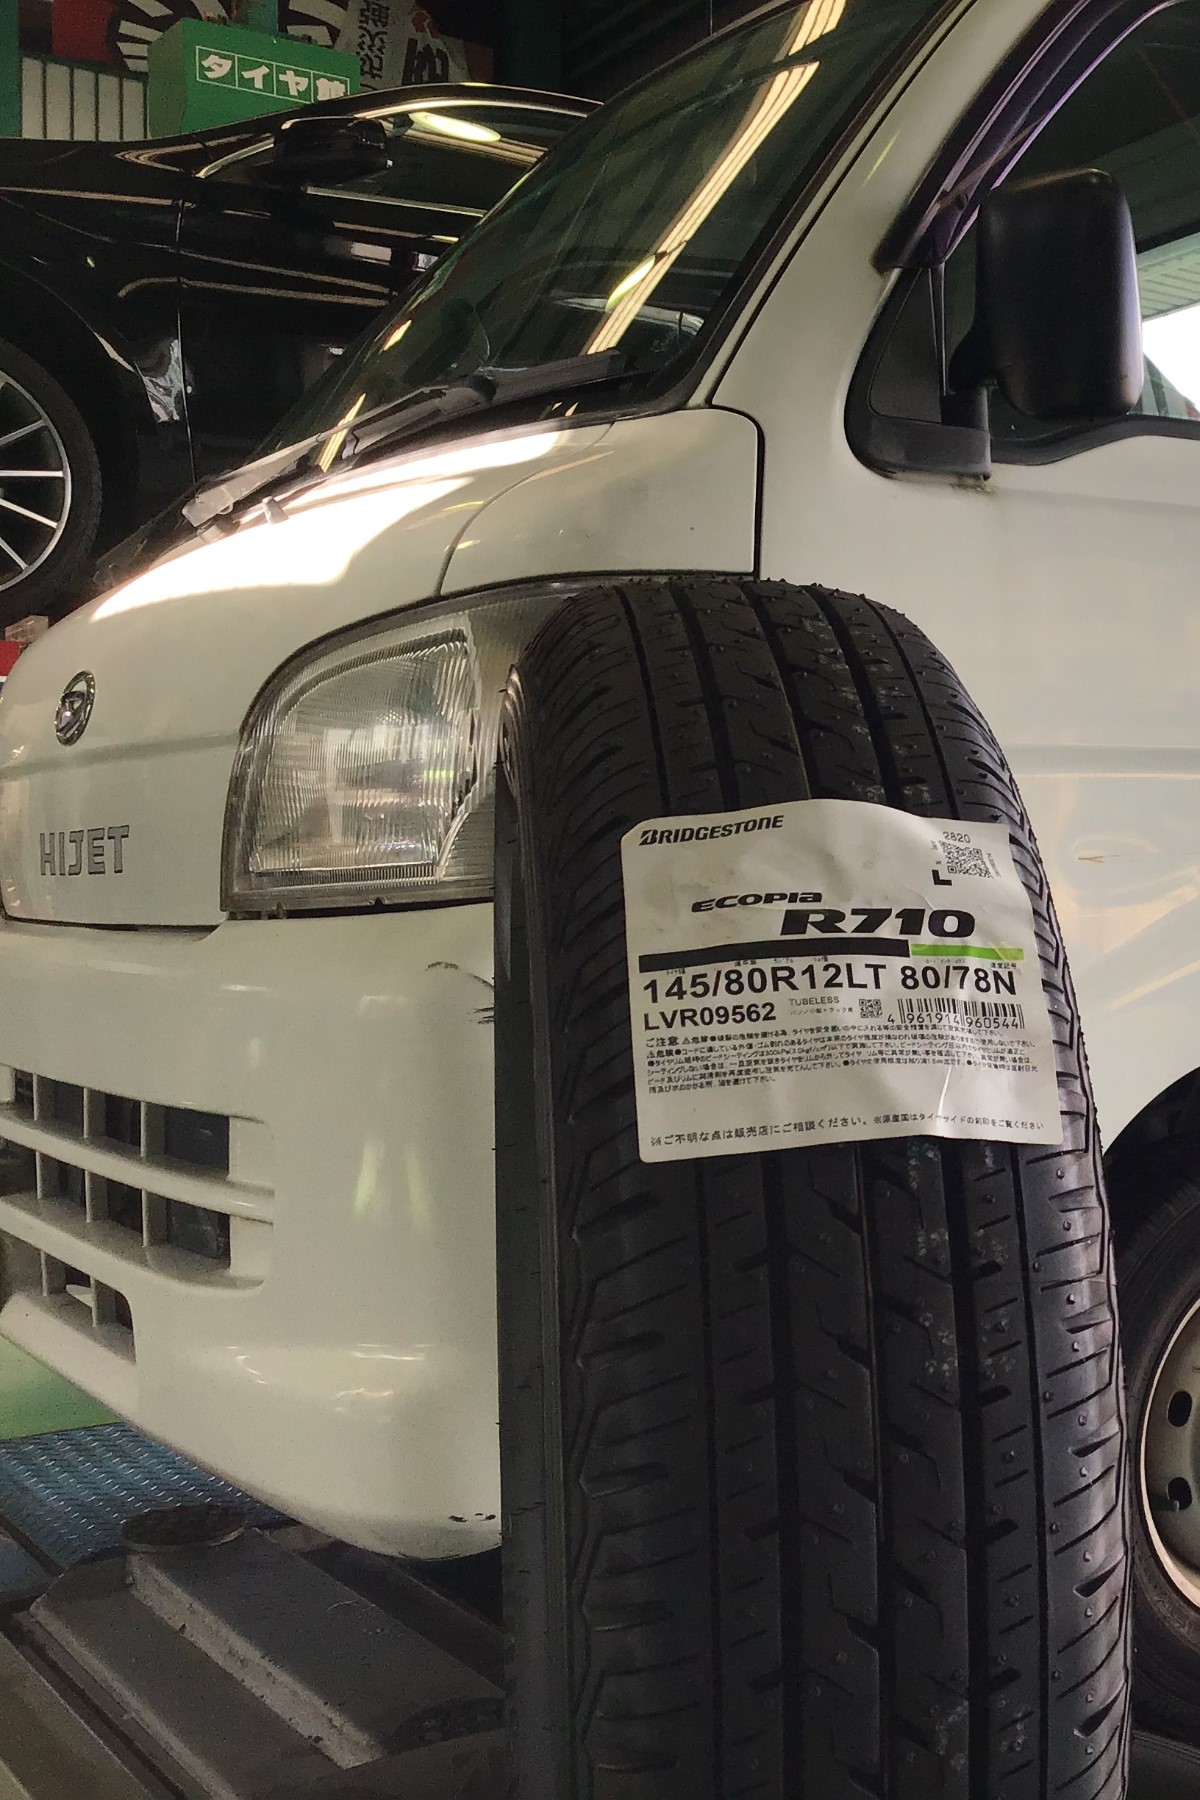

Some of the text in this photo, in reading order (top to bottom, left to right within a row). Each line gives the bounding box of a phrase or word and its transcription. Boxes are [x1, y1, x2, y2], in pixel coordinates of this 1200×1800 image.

[638, 815, 784, 846] BRIDGESTONE
[943, 831, 971, 844] 2820
[40, 825, 130, 876] HIJET
[931, 869, 953, 886] L
[780, 908, 976, 939] R710
[643, 962, 1017, 1004] 145/80R12LT 80/78N
[789, 996, 840, 1006] TUBELESS
[644, 1002, 777, 1032] LVR09562
[906, 1012, 960, 1026] 961914
[965, 1017, 1019, 1030] 960544
